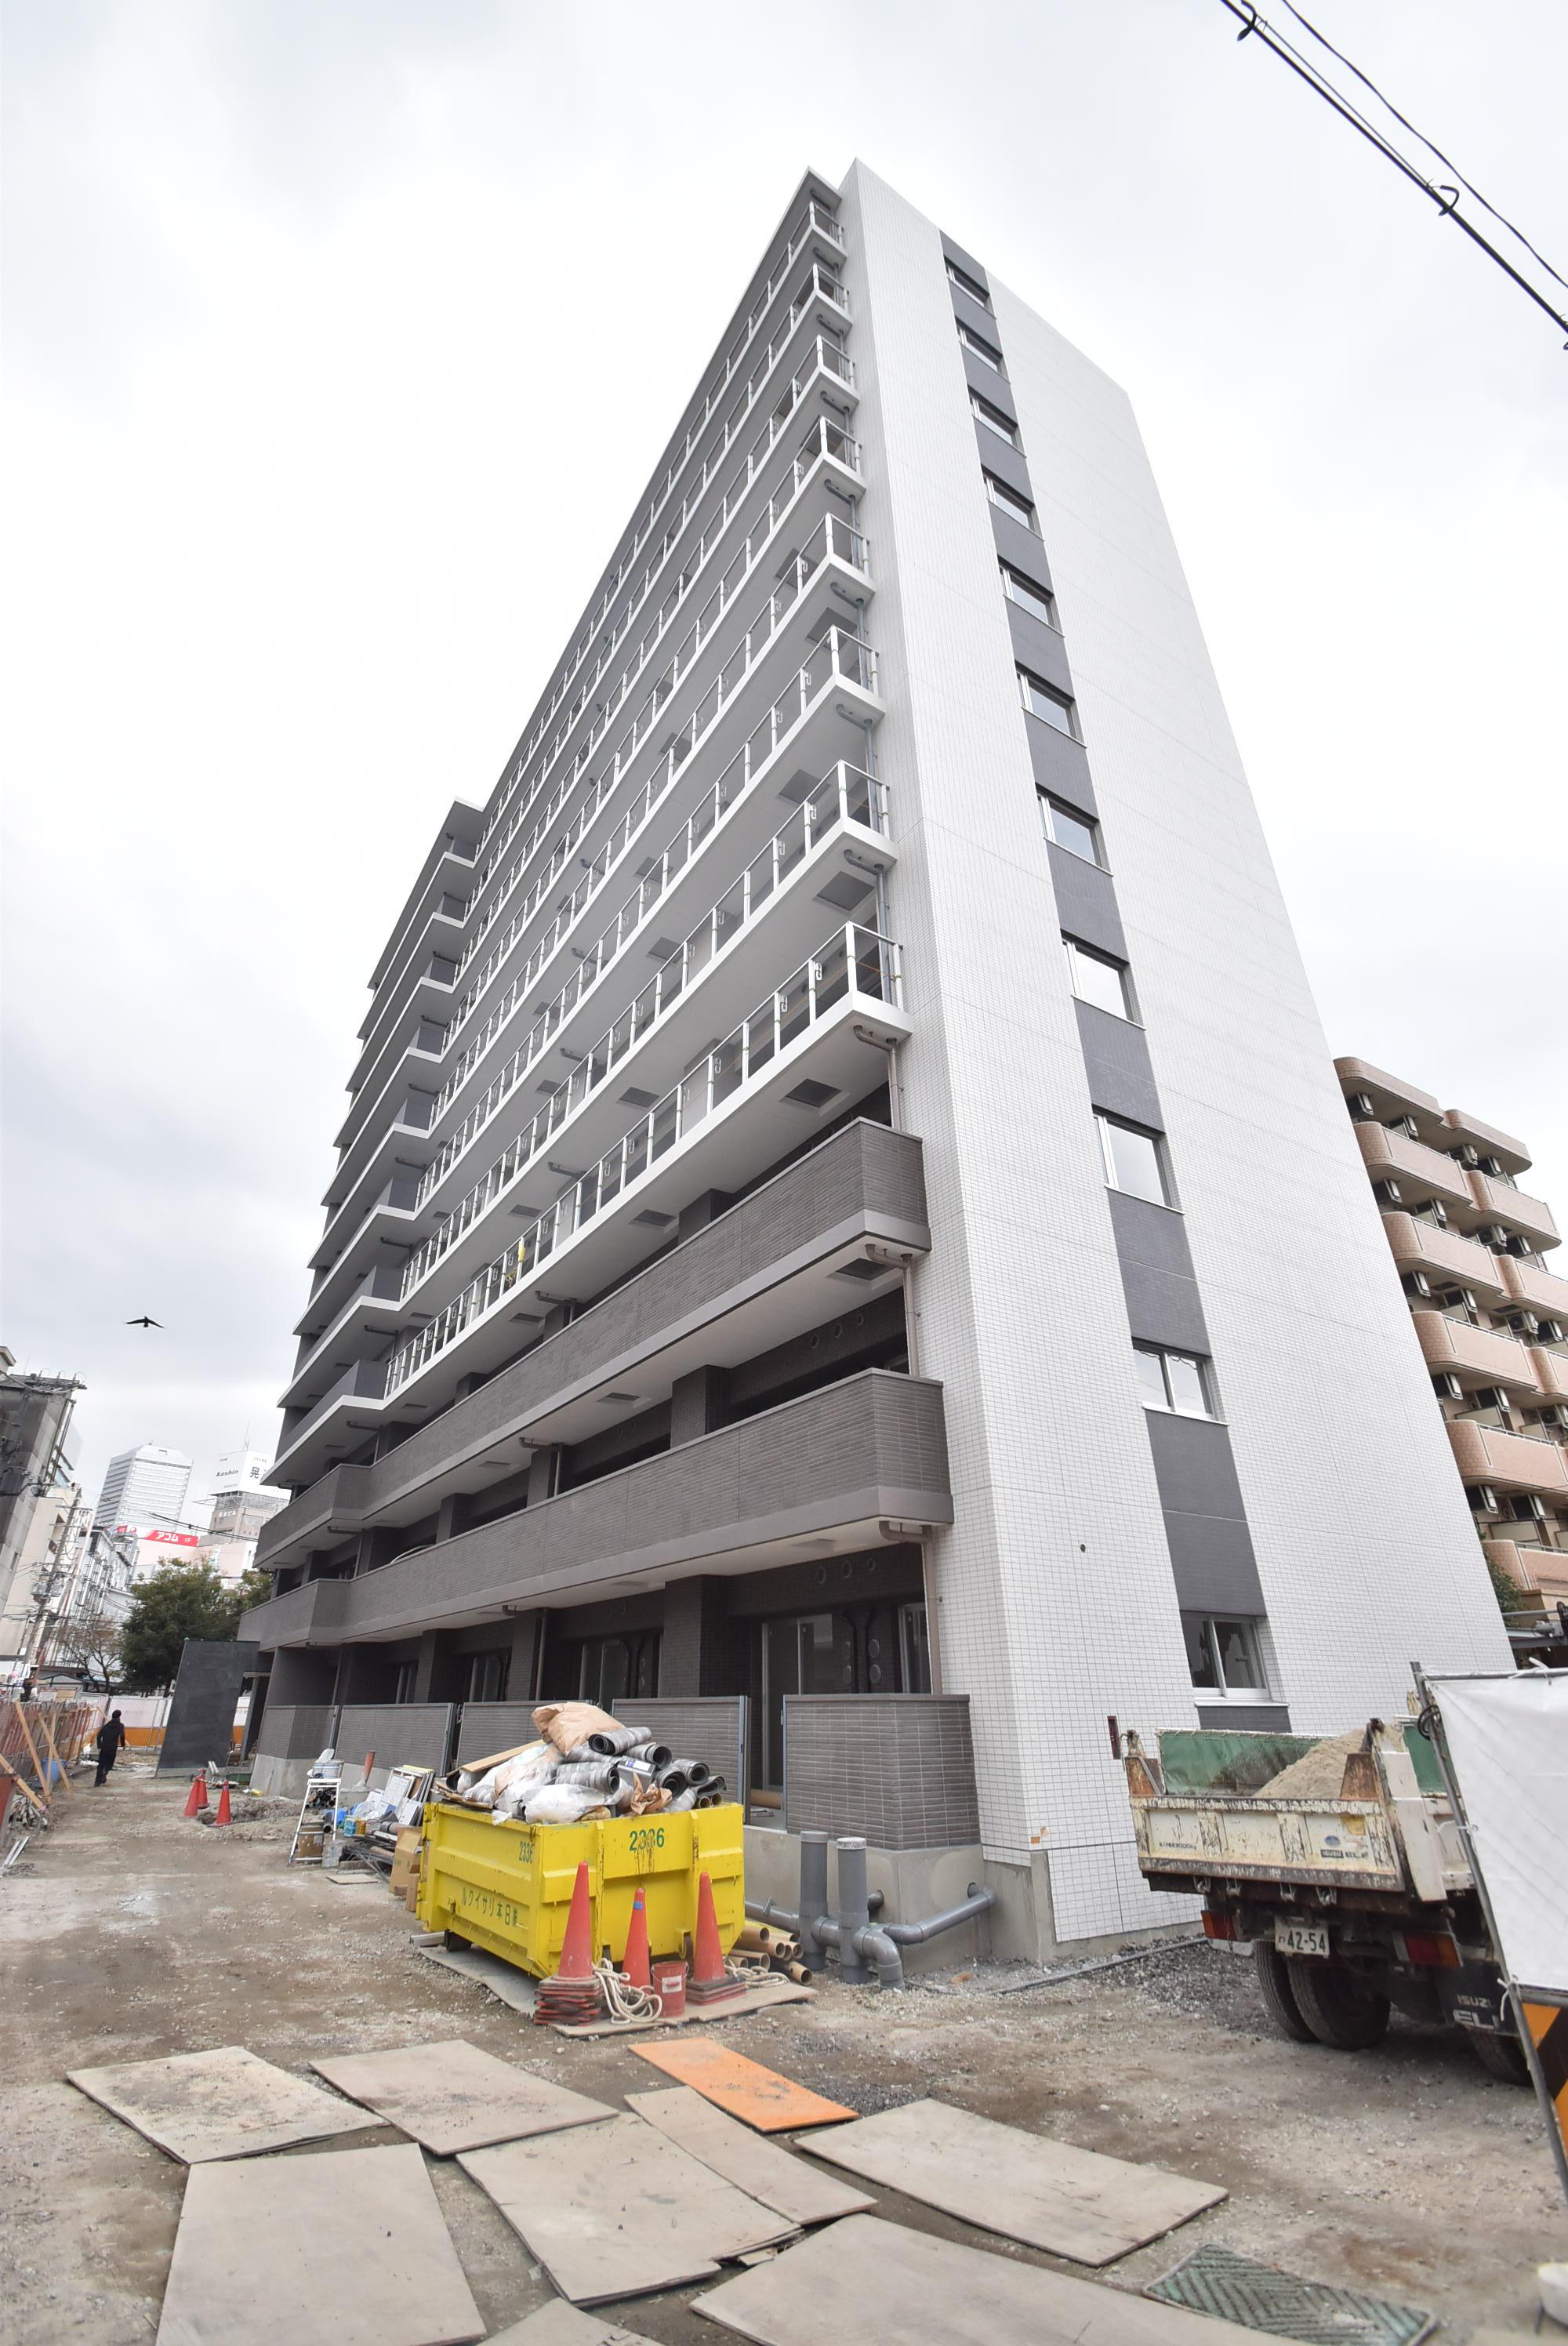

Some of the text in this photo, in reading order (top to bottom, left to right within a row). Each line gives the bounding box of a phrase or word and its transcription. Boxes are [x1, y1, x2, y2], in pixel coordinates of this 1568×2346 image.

[156, 1531, 179, 1542] アコム
[1287, 1930, 1327, 1952] 42-54
